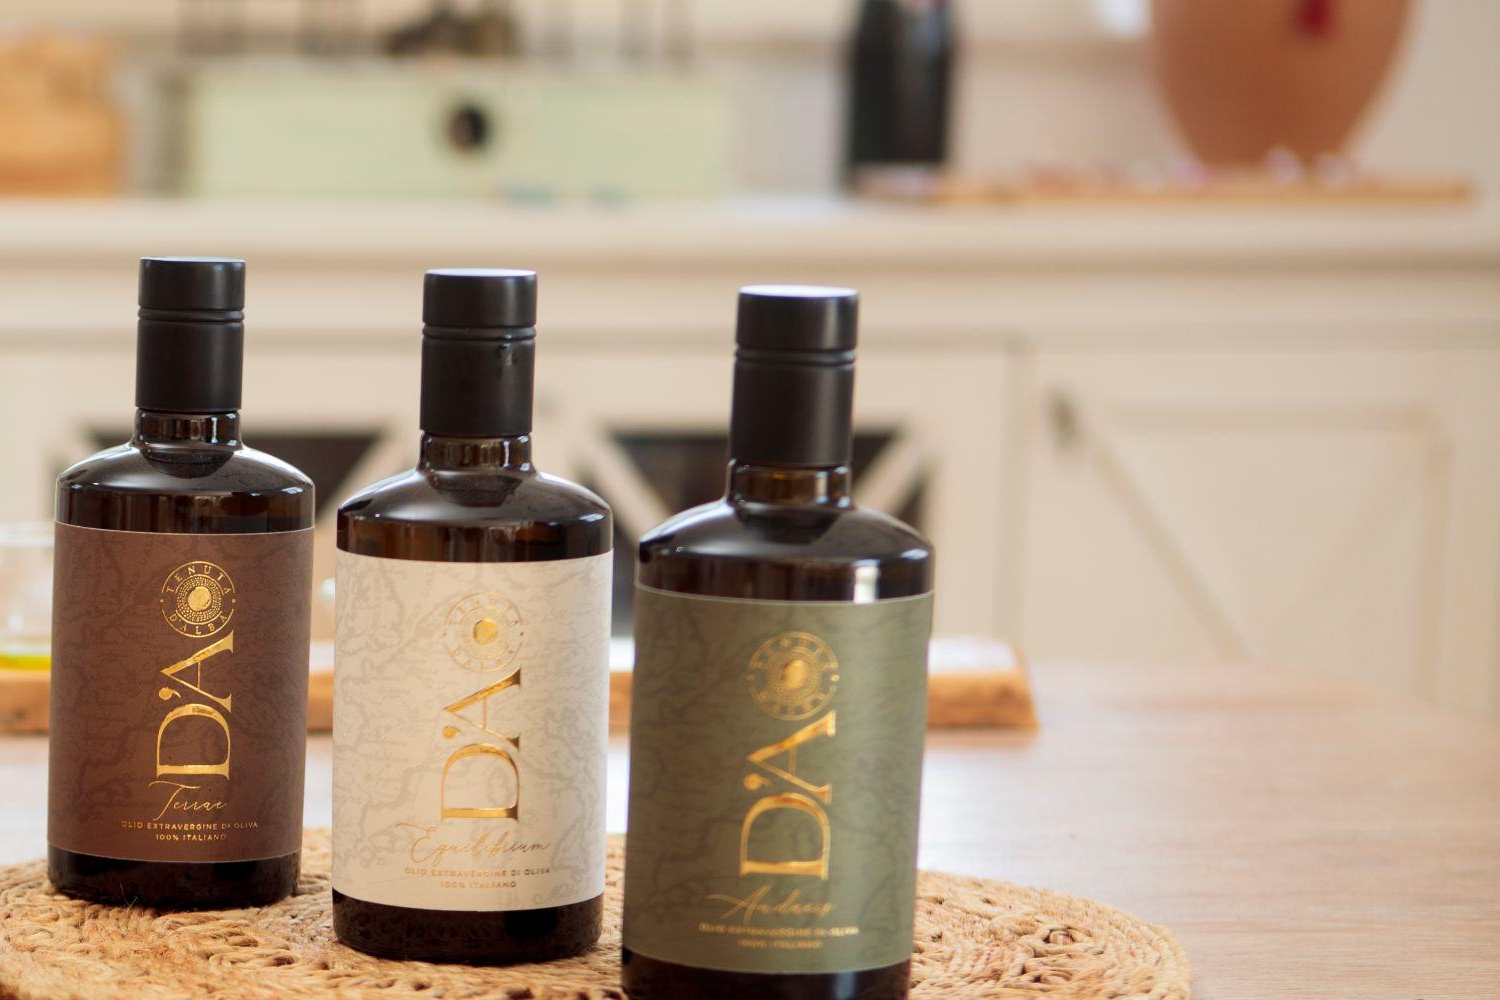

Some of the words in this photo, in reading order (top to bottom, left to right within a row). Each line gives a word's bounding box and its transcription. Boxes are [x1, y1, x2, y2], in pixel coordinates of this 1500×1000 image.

[165, 565, 232, 594] TENUTA
[156, 630, 234, 781] D'A
[440, 668, 522, 823] D'A
[148, 780, 228, 821] Terrae
[739, 709, 837, 881] D'A
[121, 820, 143, 829] OLIO
[146, 822, 218, 831] EXTRAVERGINE
[233, 821, 258, 829] OLIVA
[155, 833, 179, 841] 100%
[182, 833, 227, 841] ITALIANO
[404, 866, 428, 876] OLIO
[430, 868, 506, 878] EXTRAVERGINE
[511, 868, 521, 877] DI
[524, 867, 550, 876] OLIVA
[468, 880, 517, 889] ITALIANO
